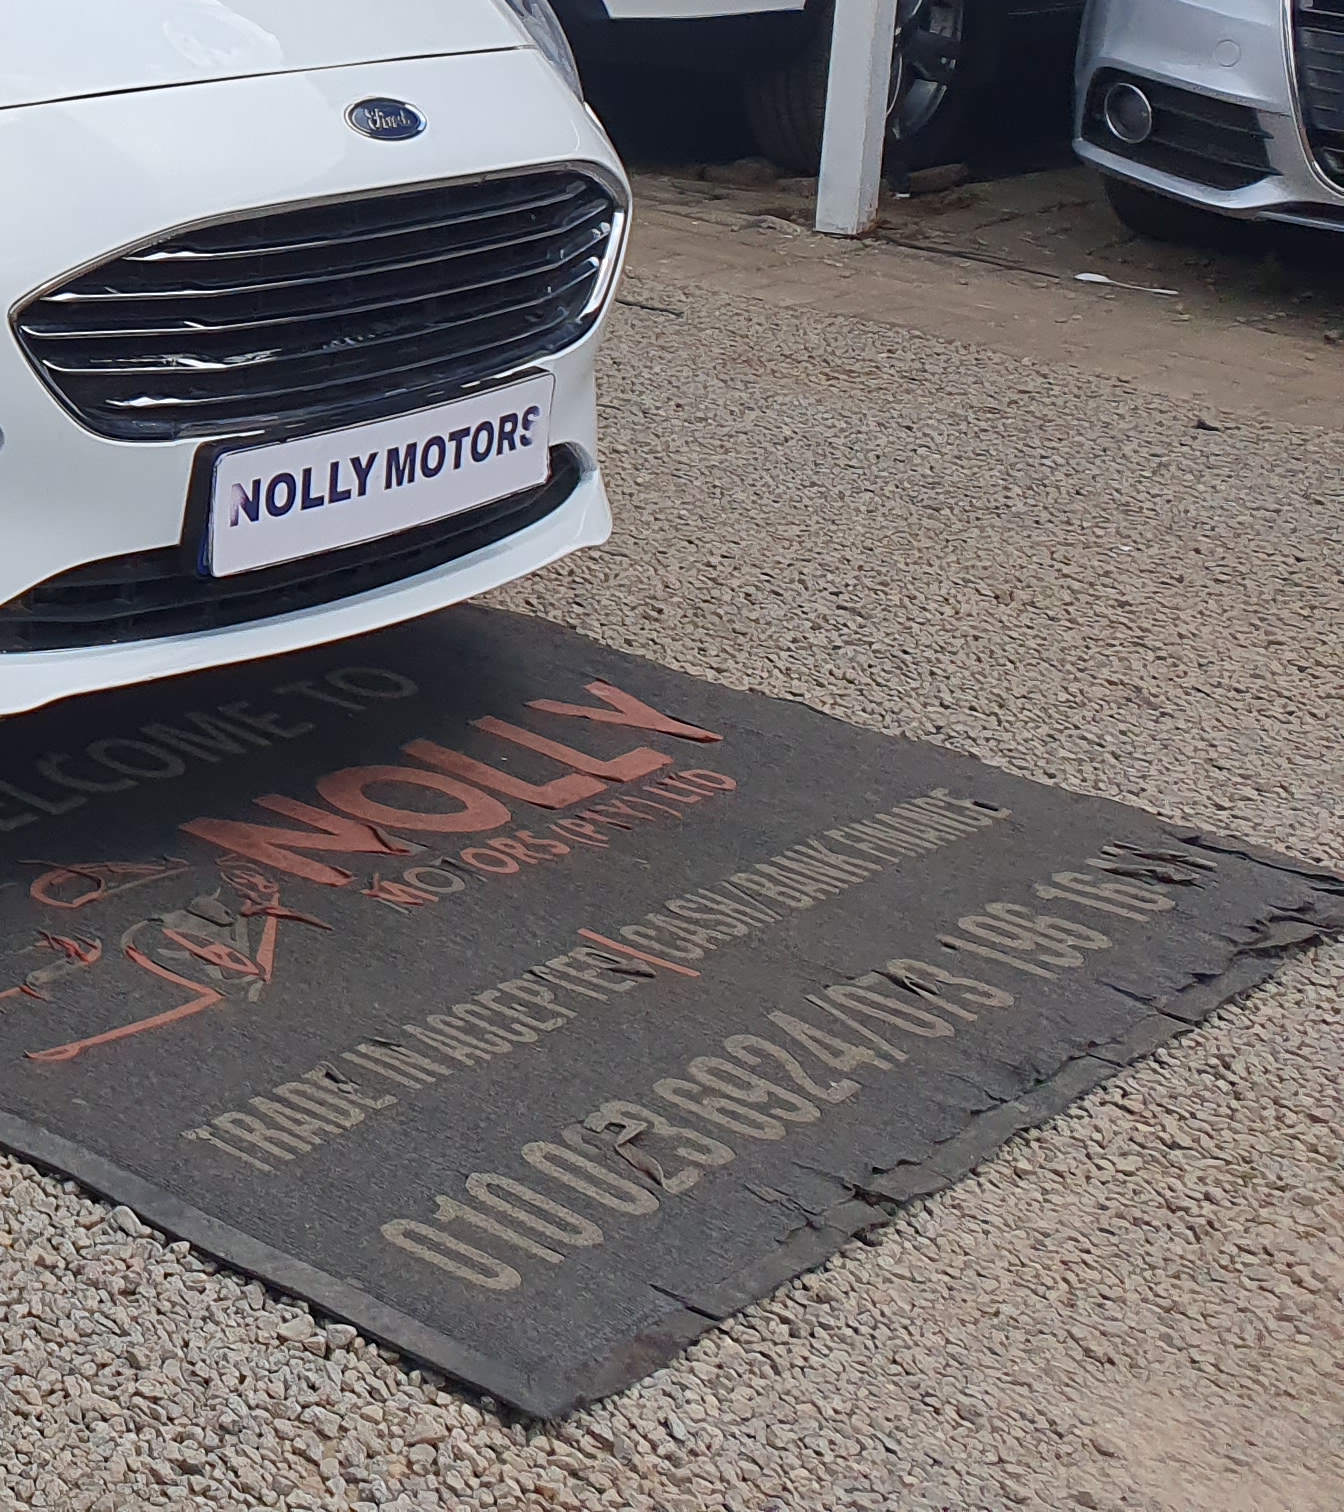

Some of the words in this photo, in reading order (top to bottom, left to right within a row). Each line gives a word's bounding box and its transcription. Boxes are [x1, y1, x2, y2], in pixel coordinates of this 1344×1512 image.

[229, 451, 378, 527] NOLLY
[384, 405, 541, 492] MOTORS
[275, 666, 419, 712] TO
[178, 677, 725, 887] NOLLY
[179, 1060, 400, 1174] TRADE
[379, 1171, 606, 1291] 010
[935, 901, 1114, 980] 196
